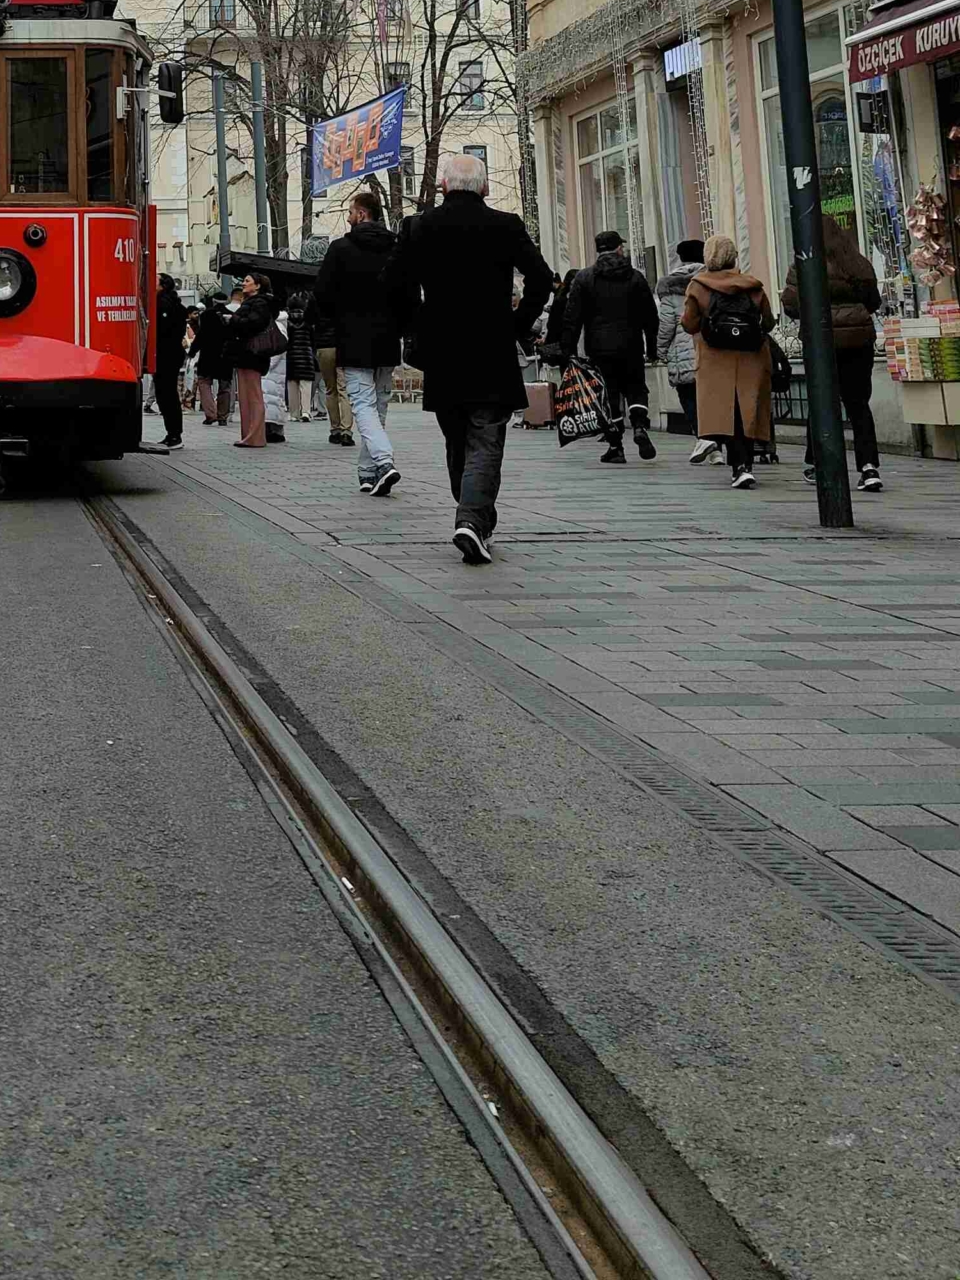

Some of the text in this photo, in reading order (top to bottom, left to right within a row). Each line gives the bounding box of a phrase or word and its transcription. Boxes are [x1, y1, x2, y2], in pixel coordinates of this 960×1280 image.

[858, 14, 960, 74] ÖZÇİÇEK KURUY
[114, 238, 135, 263] 410
[96, 310, 106, 322] VE
[578, 419, 602, 434] ATIK
